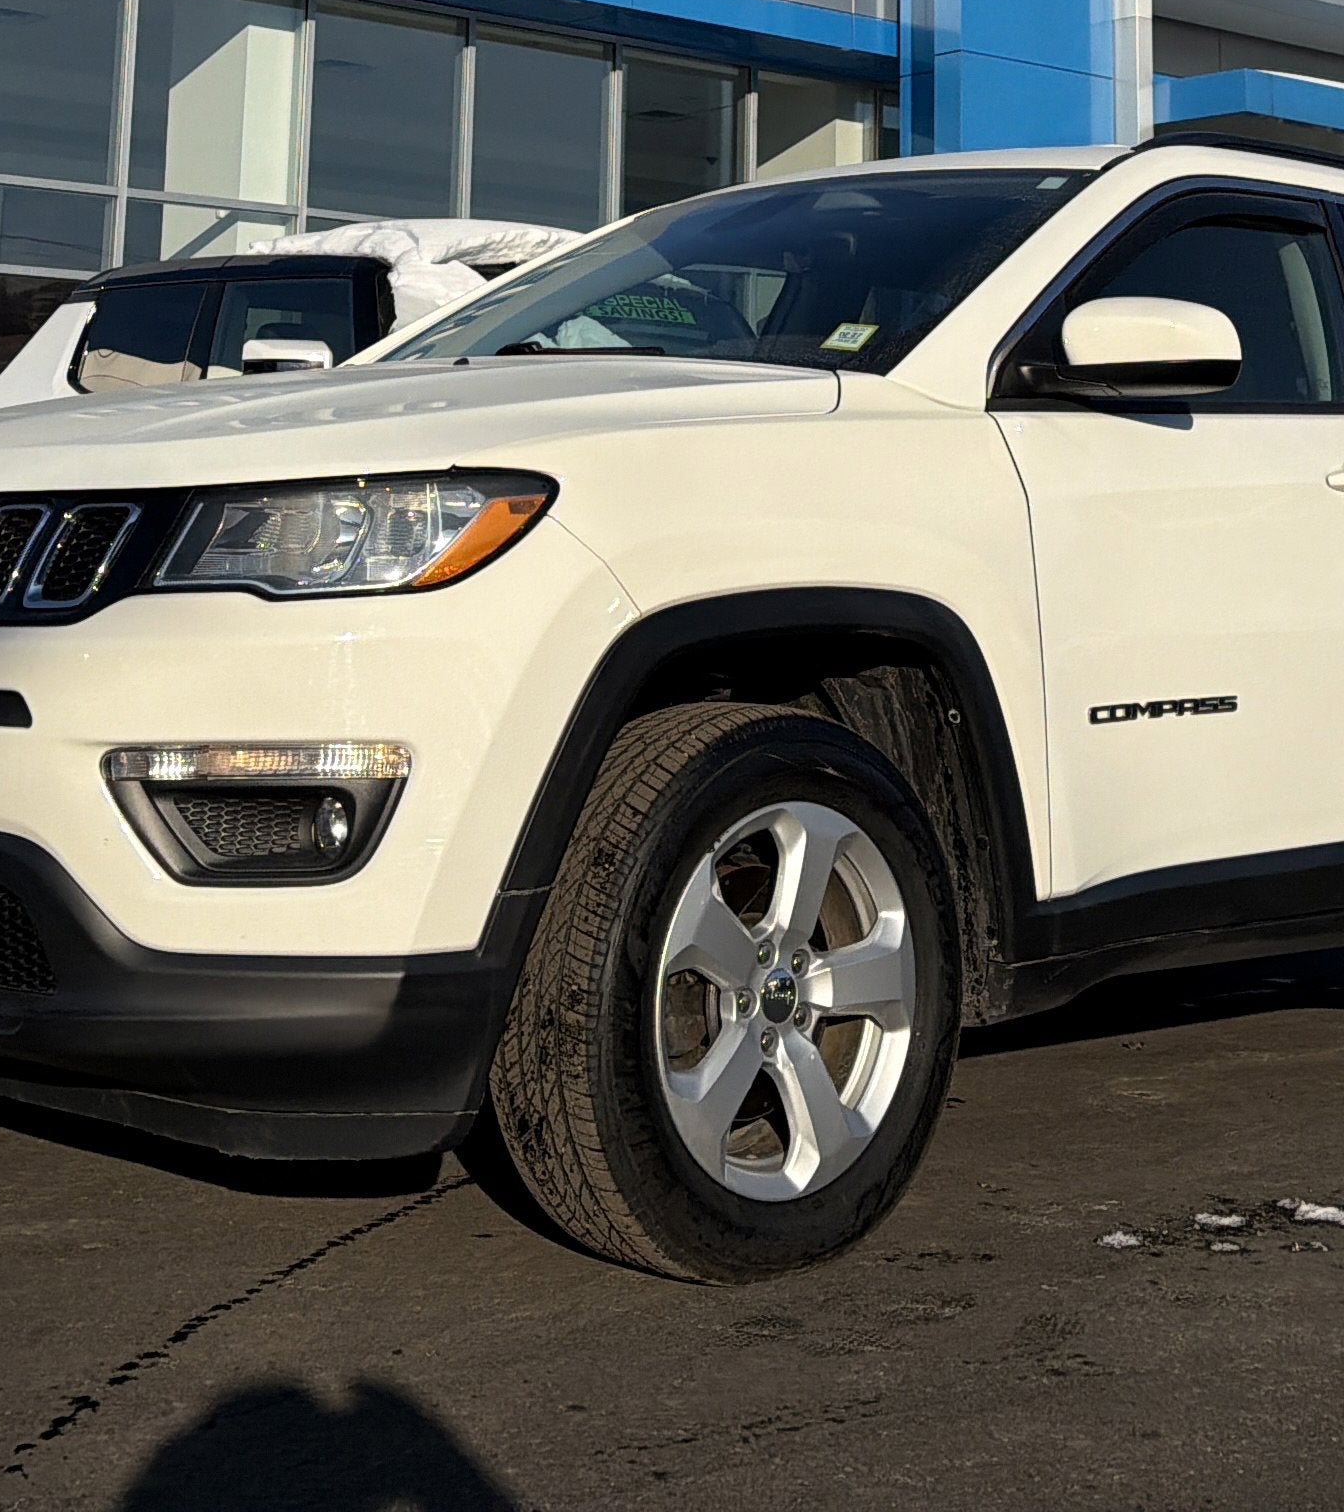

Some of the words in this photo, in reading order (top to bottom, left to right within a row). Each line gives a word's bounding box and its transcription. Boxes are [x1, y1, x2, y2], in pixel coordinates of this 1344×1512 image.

[604, 294, 688, 311] SPECIAL
[598, 306, 684, 322] SAVINGS!
[1088, 695, 1238, 724] COMPASS
